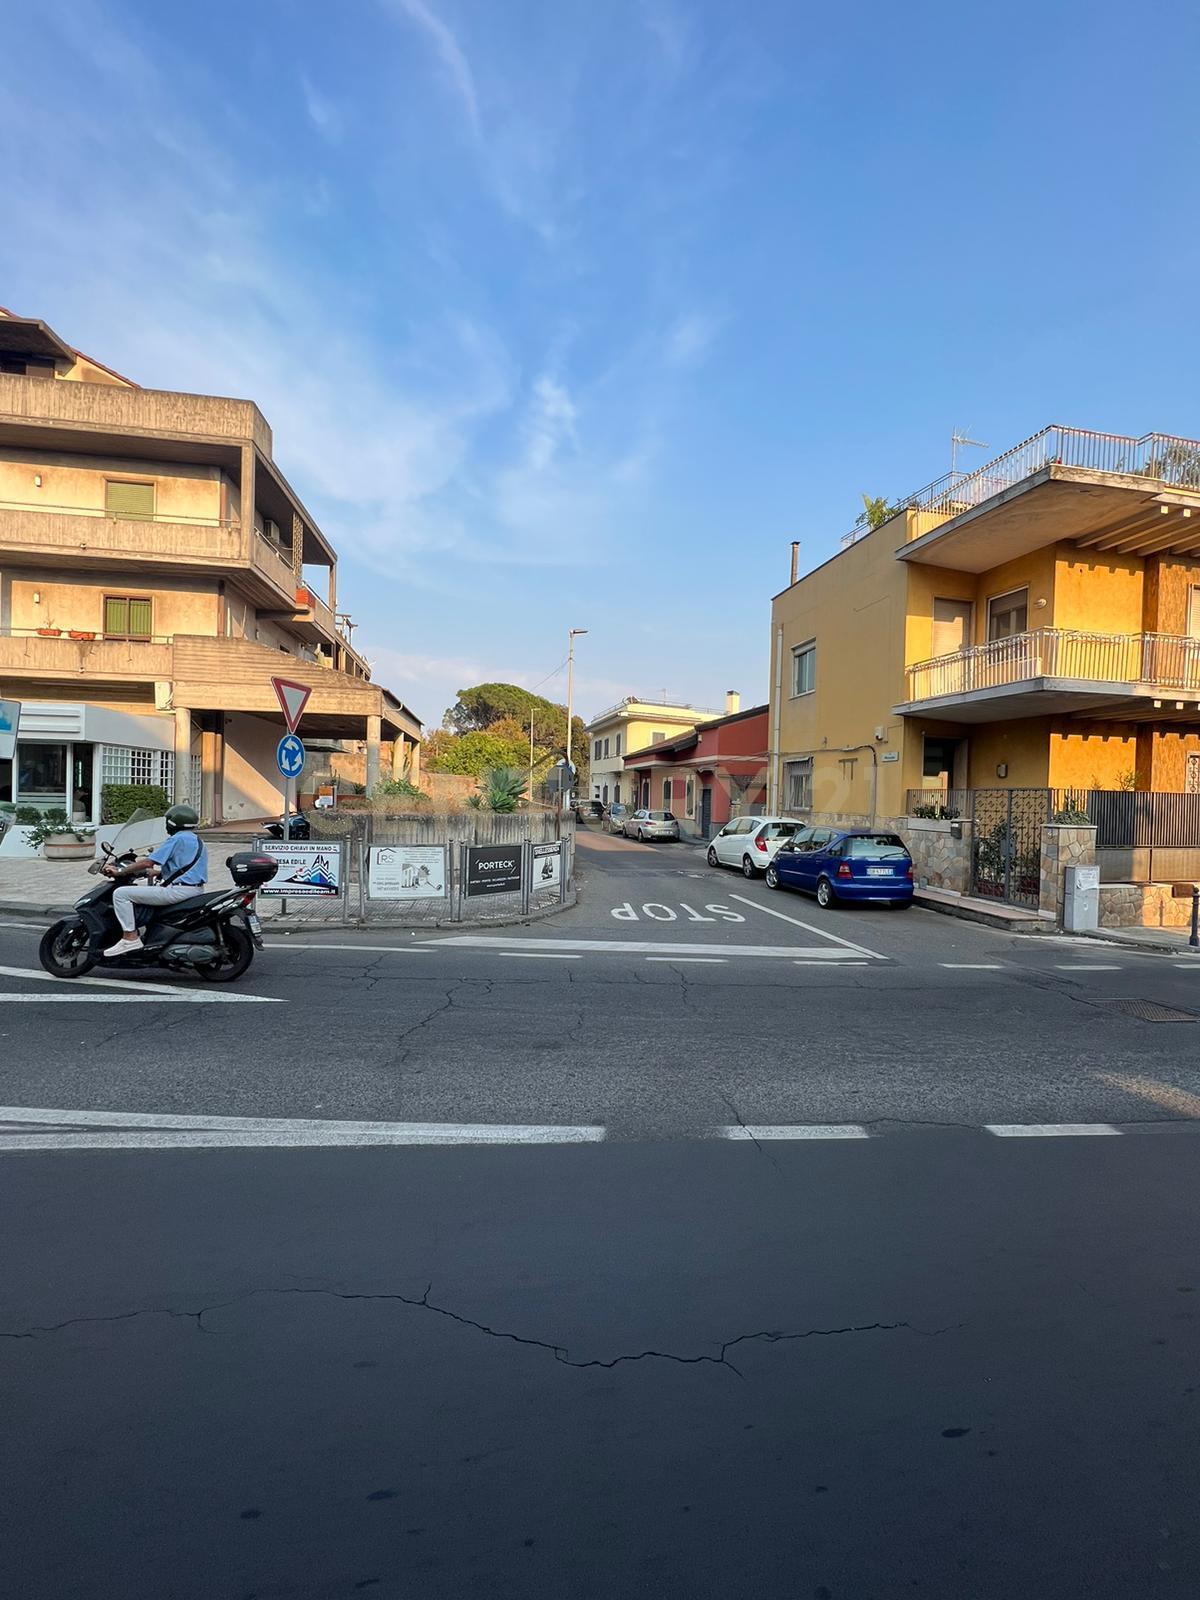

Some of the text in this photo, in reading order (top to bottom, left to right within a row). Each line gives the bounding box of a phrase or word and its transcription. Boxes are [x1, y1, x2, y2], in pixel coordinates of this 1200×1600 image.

[381, 854, 394, 864] RS
[478, 860, 514, 870] PORTECK
[610, 902, 746, 922] STOP
